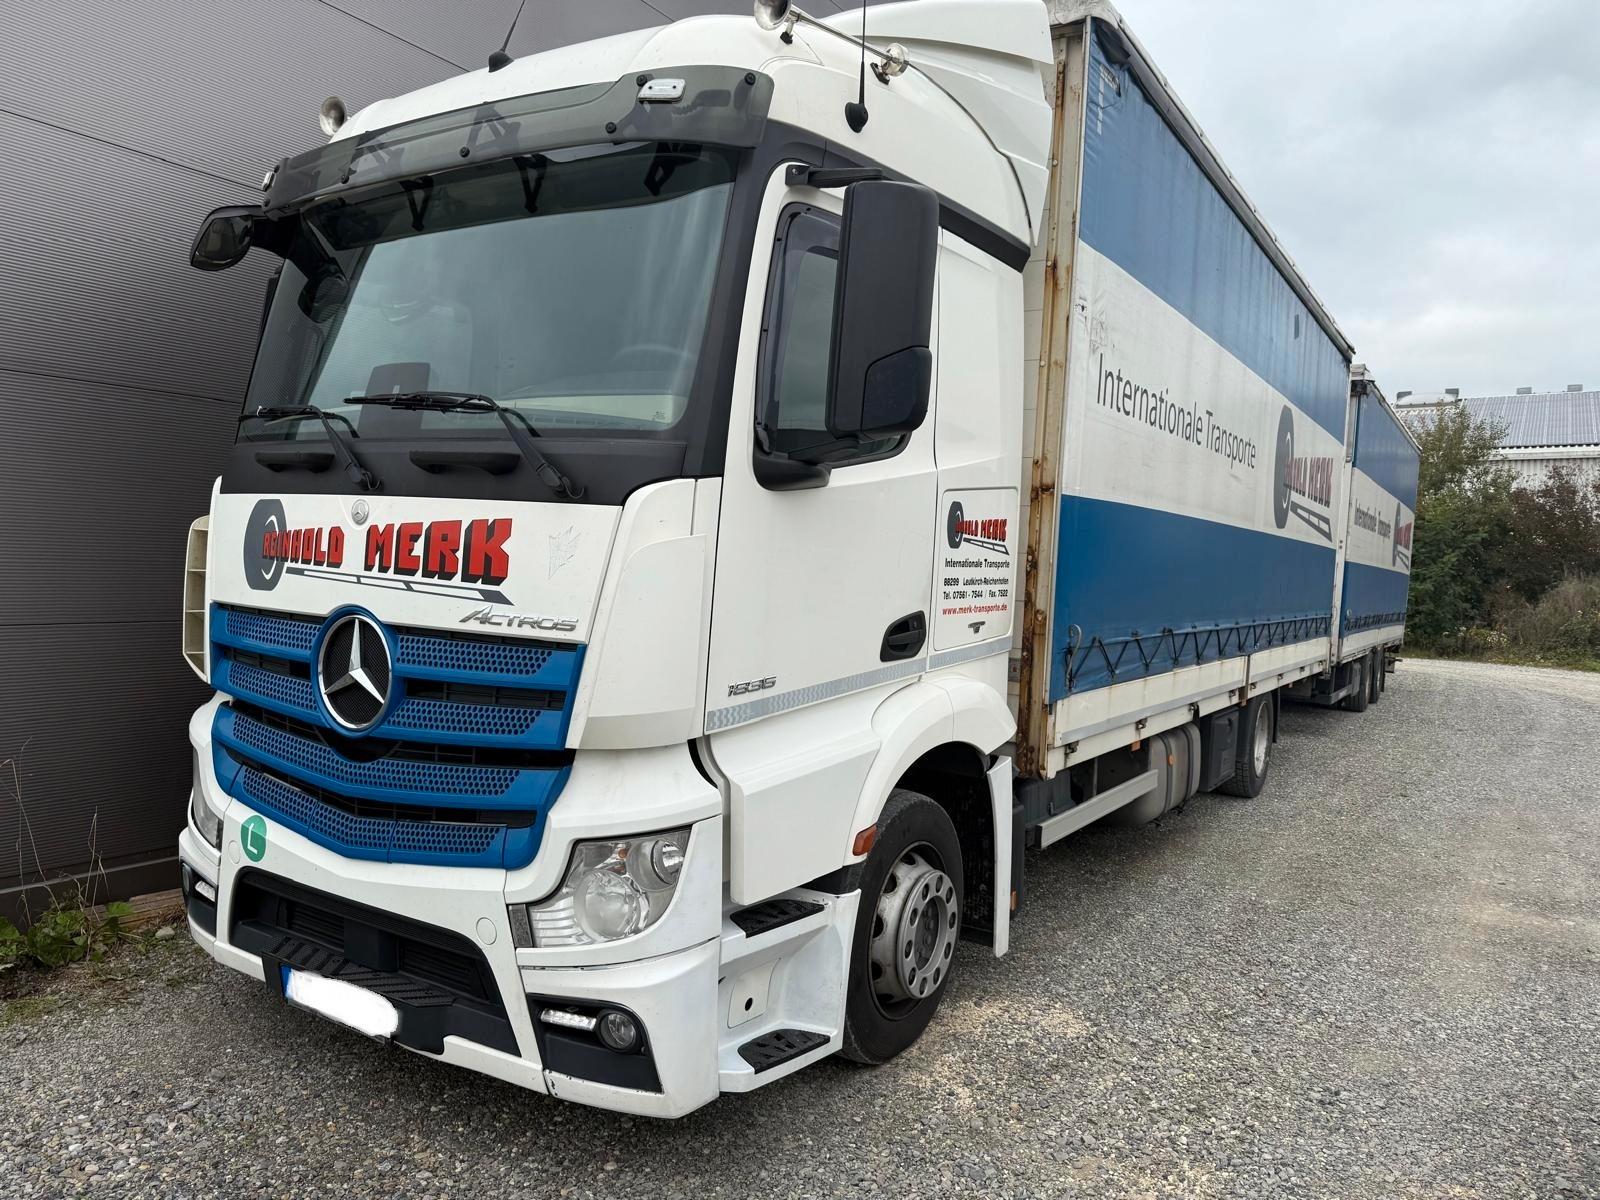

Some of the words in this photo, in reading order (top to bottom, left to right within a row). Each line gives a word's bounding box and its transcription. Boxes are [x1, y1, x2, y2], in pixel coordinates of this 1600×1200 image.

[1097, 352, 1203, 446] Internationale
[1206, 409, 1256, 469] Transporte
[980, 518, 1008, 542] MERK
[262, 526, 345, 568] REINHOLD
[364, 518, 512, 587] MERK
[945, 558, 983, 568] Internationale
[984, 559, 1010, 570] Transporte
[944, 578, 959, 586] 88299
[943, 603, 1007, 615] www.merk-transporte.de
[246, 822, 259, 855] L
